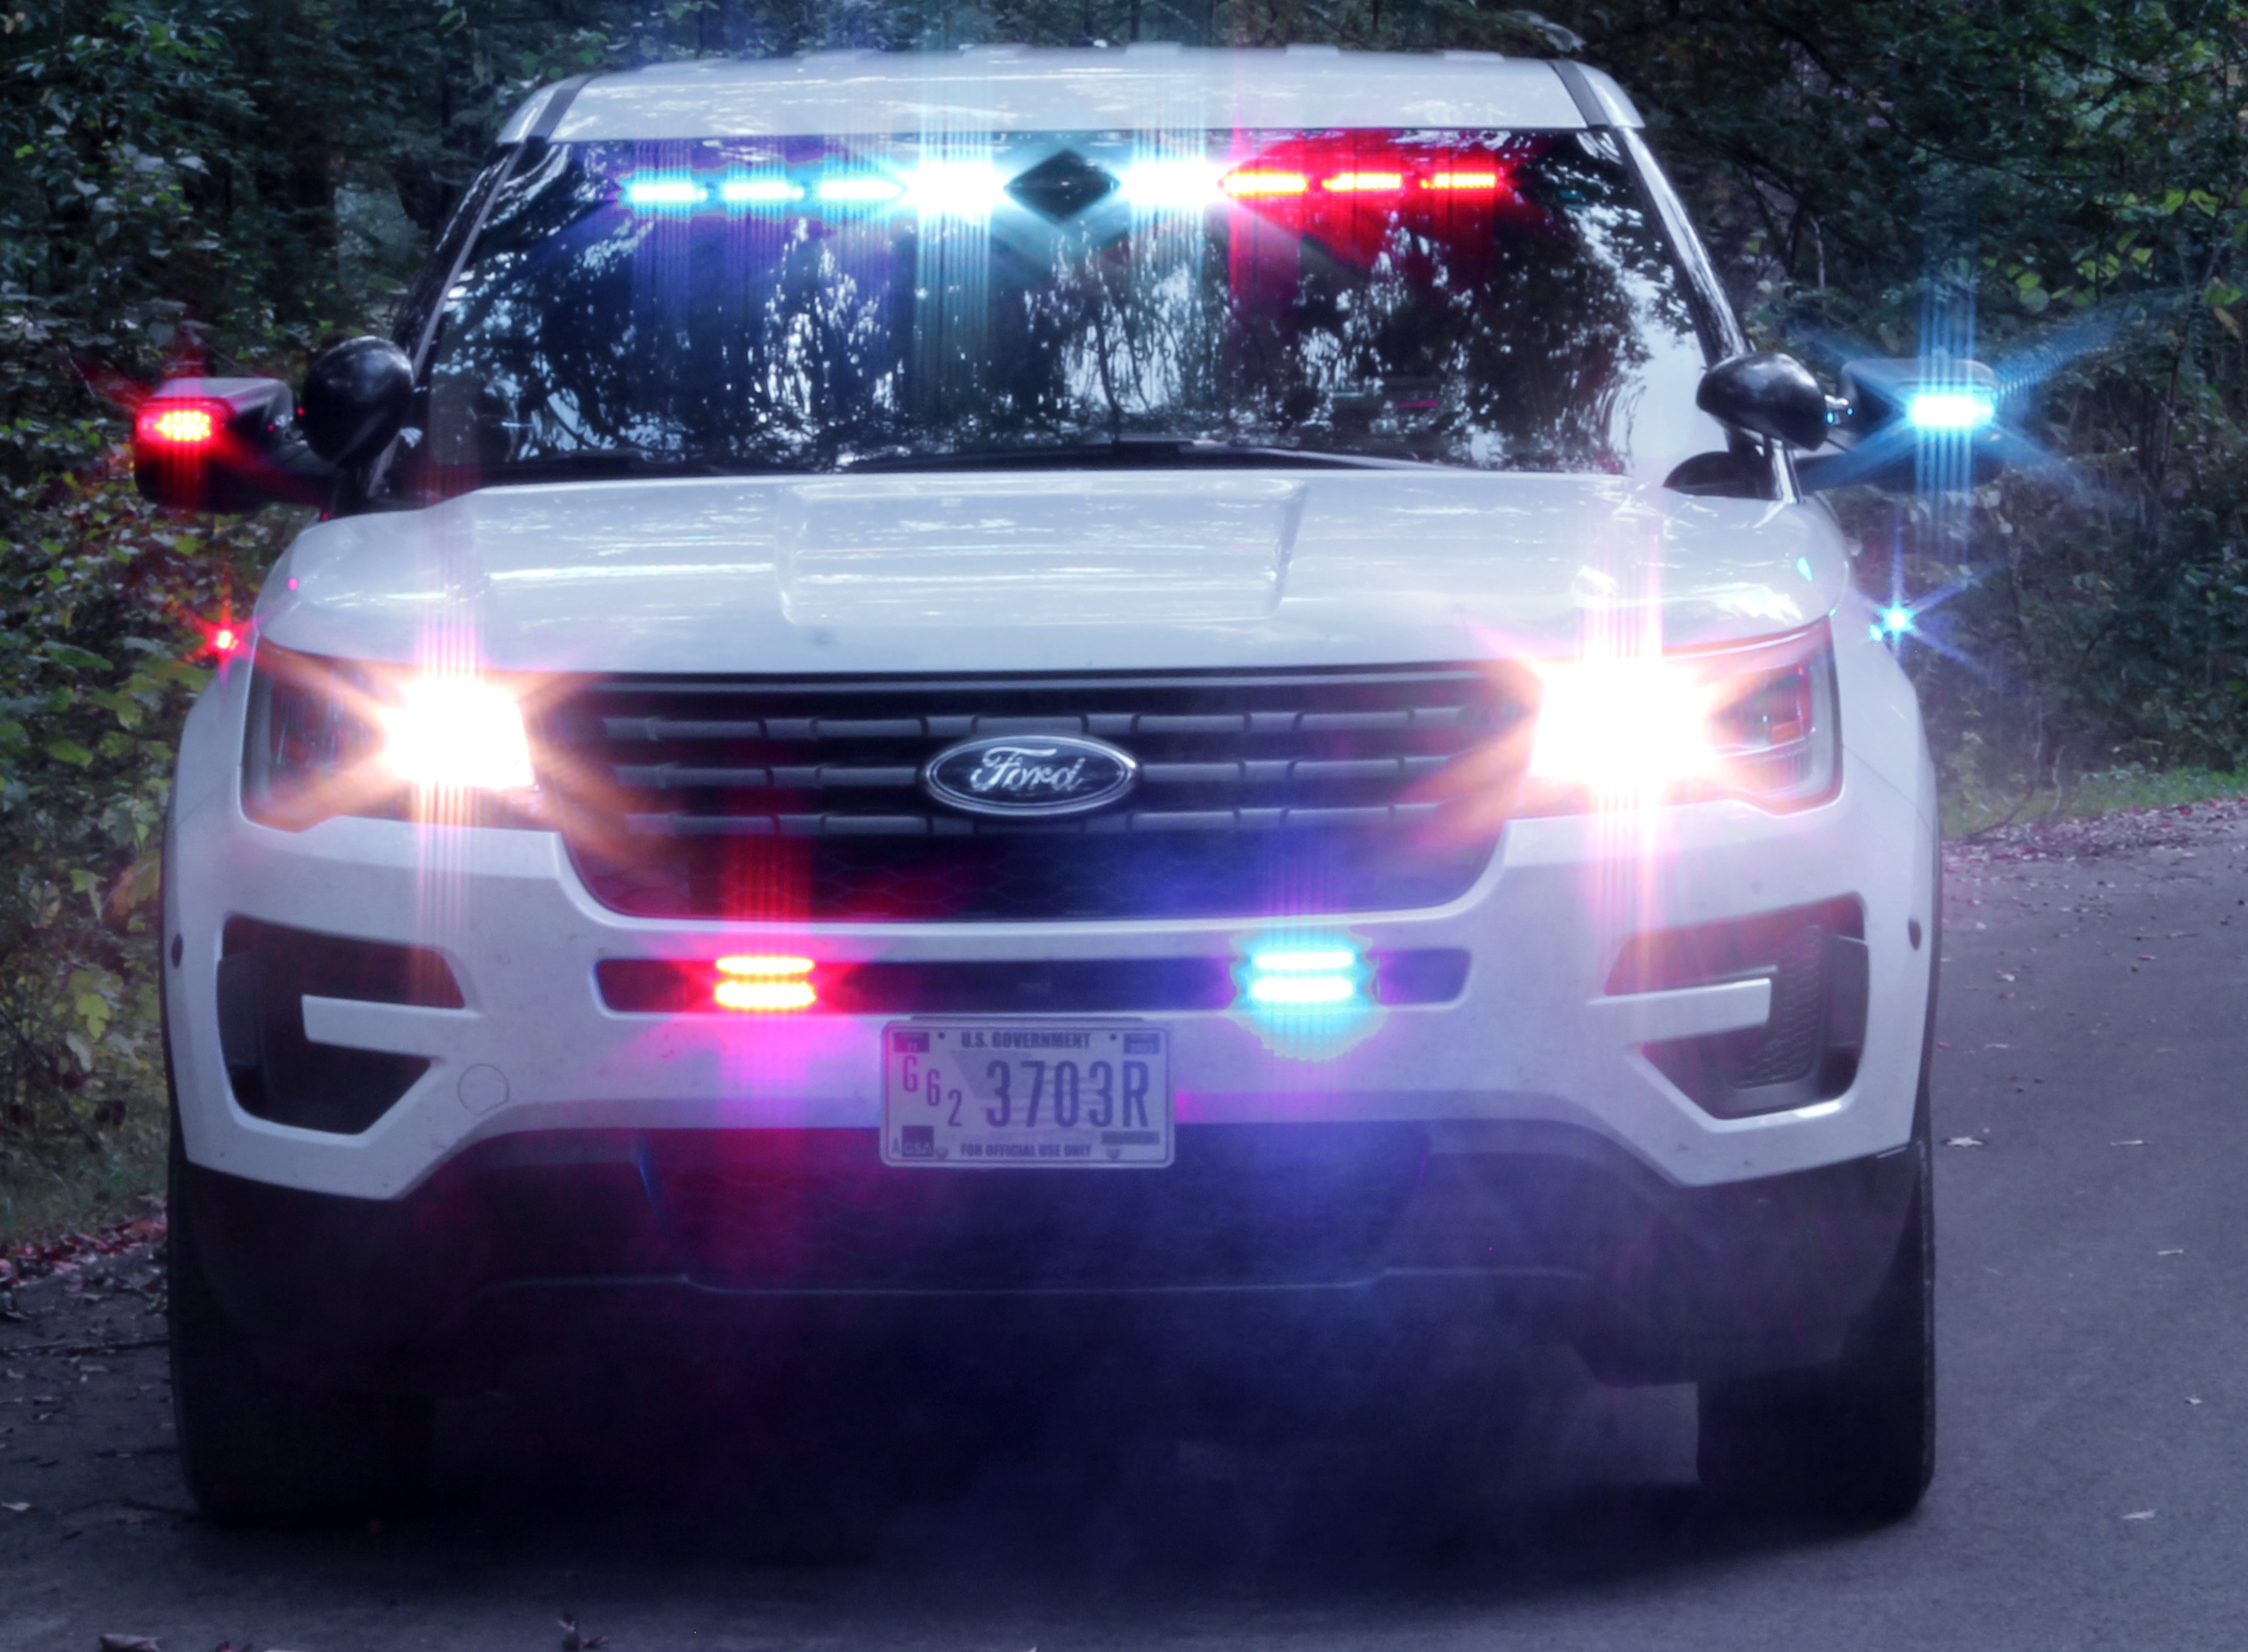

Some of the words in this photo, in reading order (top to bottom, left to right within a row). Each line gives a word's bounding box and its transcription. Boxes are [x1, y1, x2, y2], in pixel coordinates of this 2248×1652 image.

[970, 746, 1086, 792] Ford
[960, 1031, 988, 1049] U.S.
[992, 1031, 1091, 1049] GOVERNMENT
[986, 1060, 1150, 1129] 3703R
[960, 1143, 983, 1157] FOR
[985, 1143, 1035, 1158] OFFICIAL
[1038, 1143, 1061, 1157] USE
[1063, 1144, 1092, 1158] ONLY
